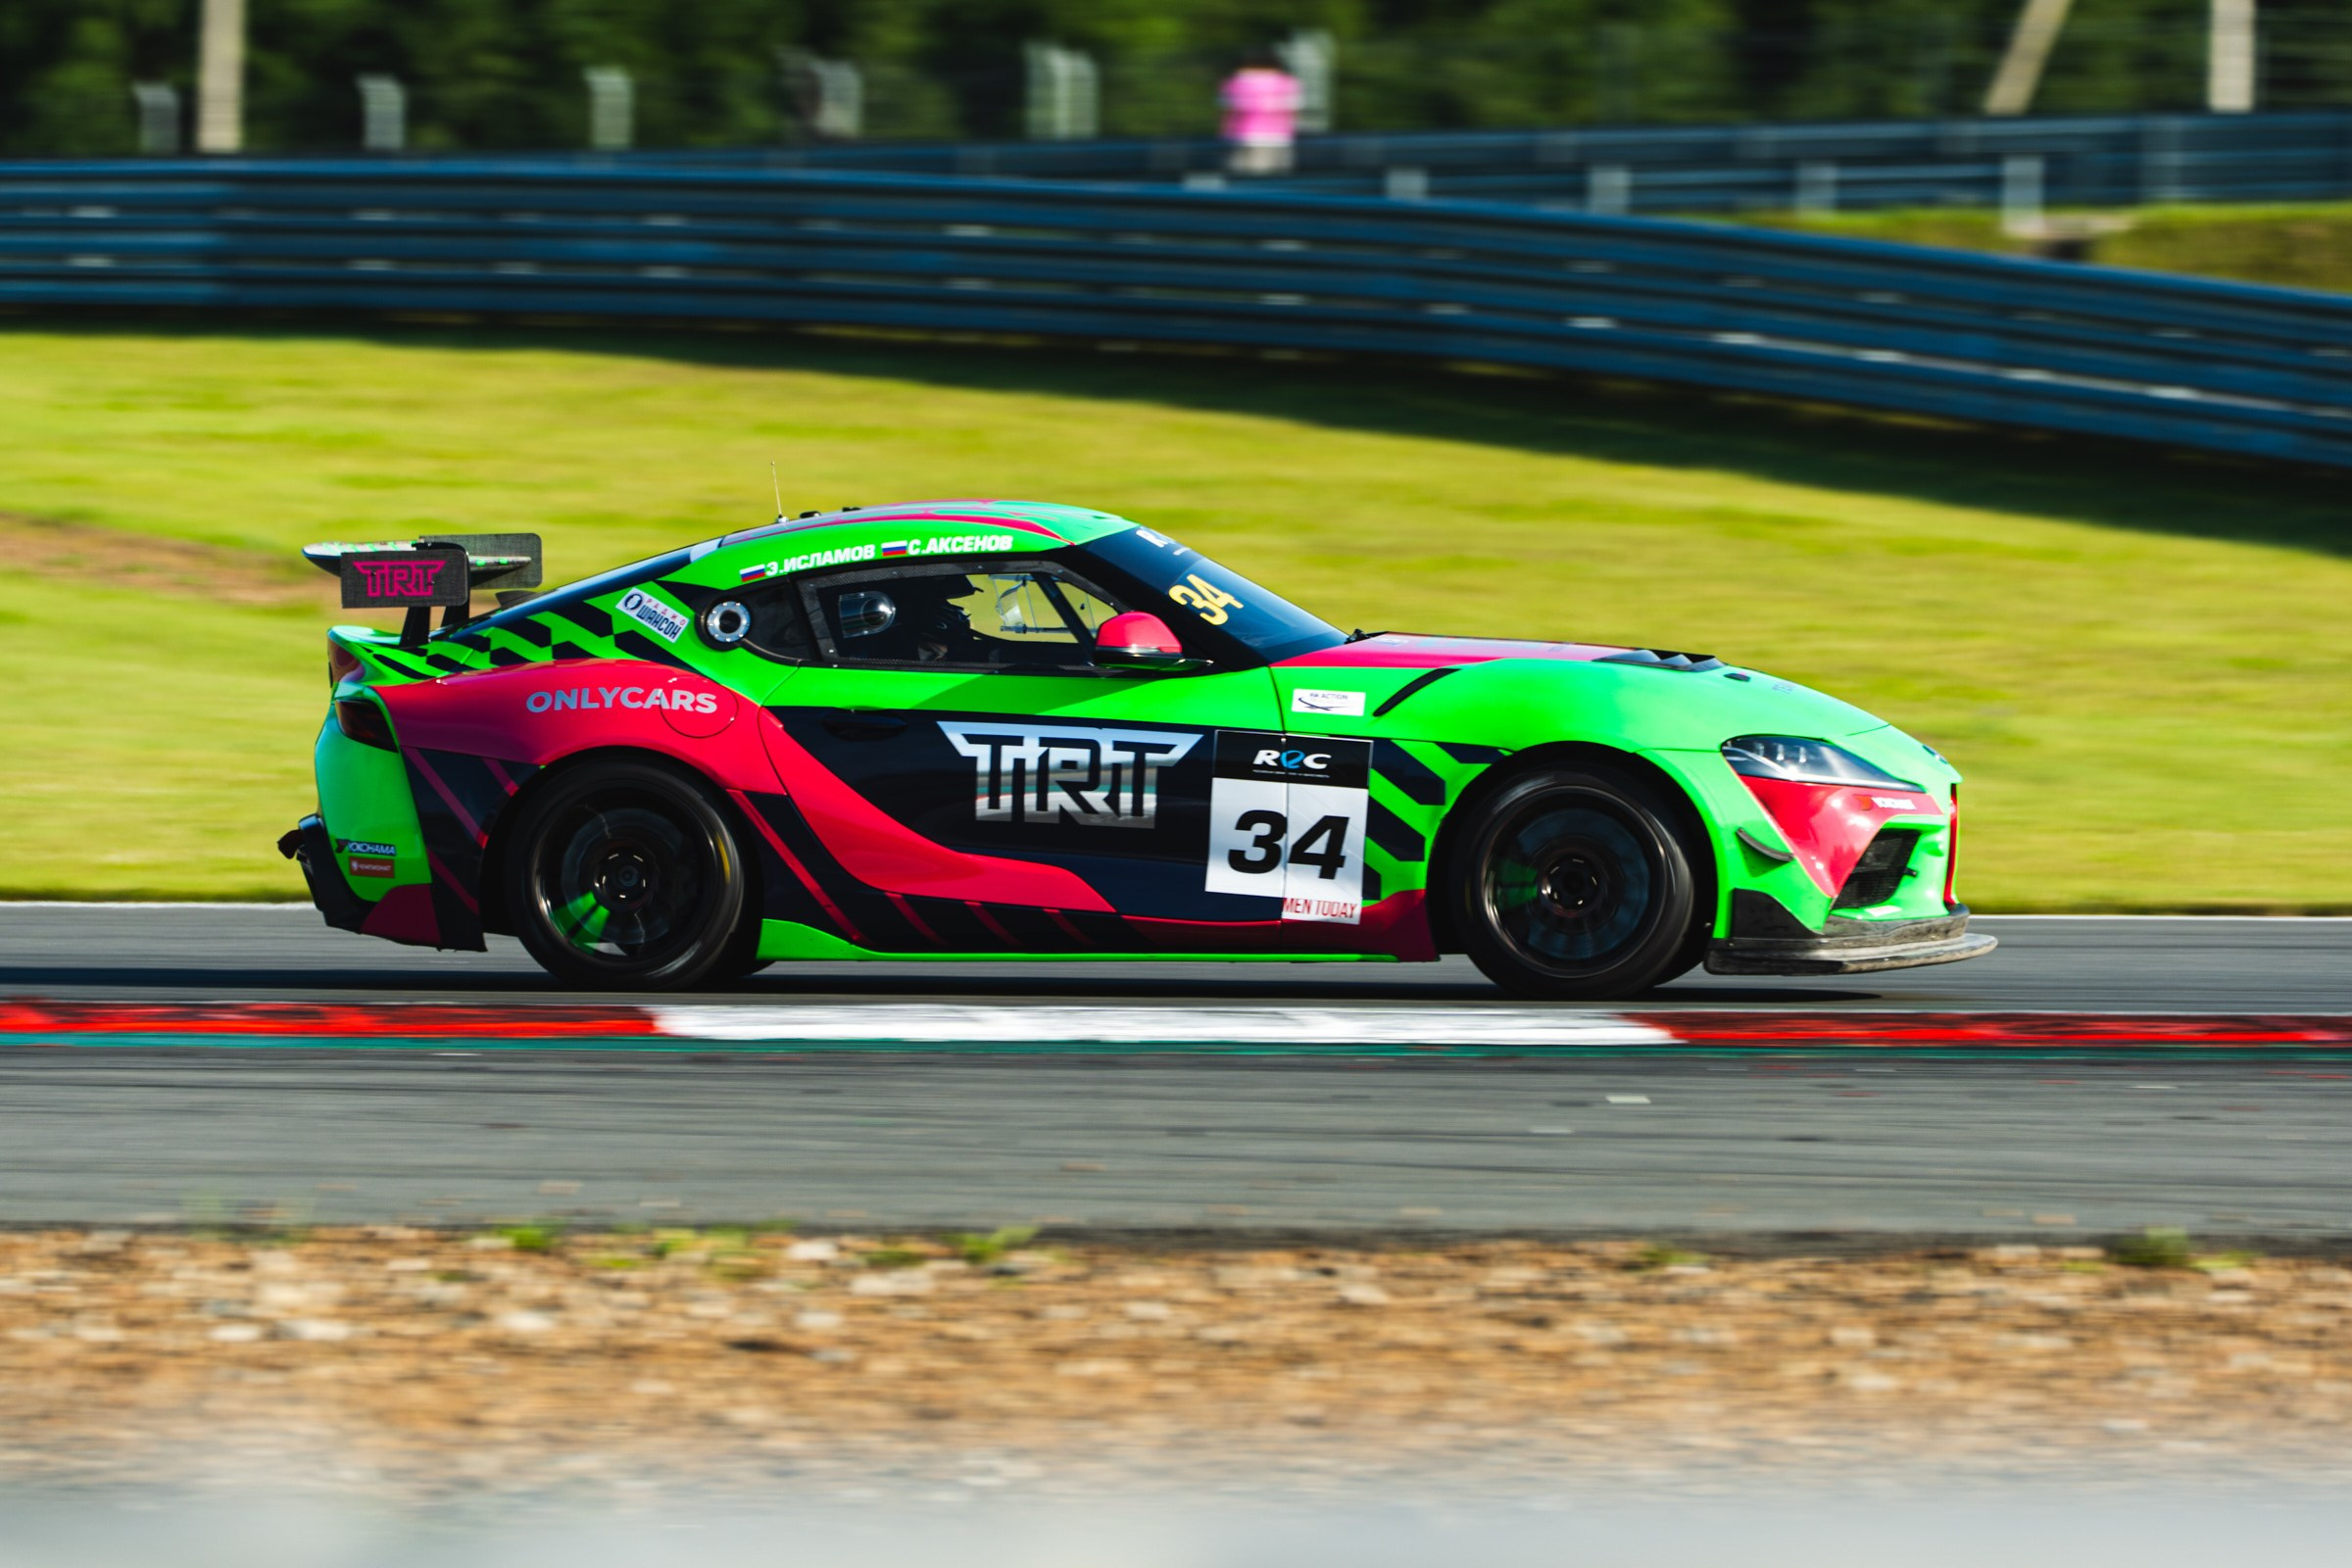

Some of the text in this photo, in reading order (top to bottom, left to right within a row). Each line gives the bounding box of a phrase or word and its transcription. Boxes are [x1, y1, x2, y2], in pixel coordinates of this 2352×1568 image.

[765, 544, 876, 577] Э.ИСЛАМОВ
[907, 534, 1014, 556] С.АКСЕНОВ
[353, 560, 447, 597] TRT
[1168, 573, 1245, 626] 34
[636, 604, 682, 639] ШАНСОН
[525, 686, 718, 714] ONLYCARS
[935, 720, 1205, 829] TRT
[1227, 808, 1350, 880] 34
[1283, 897, 1359, 919] MEN TODAY
